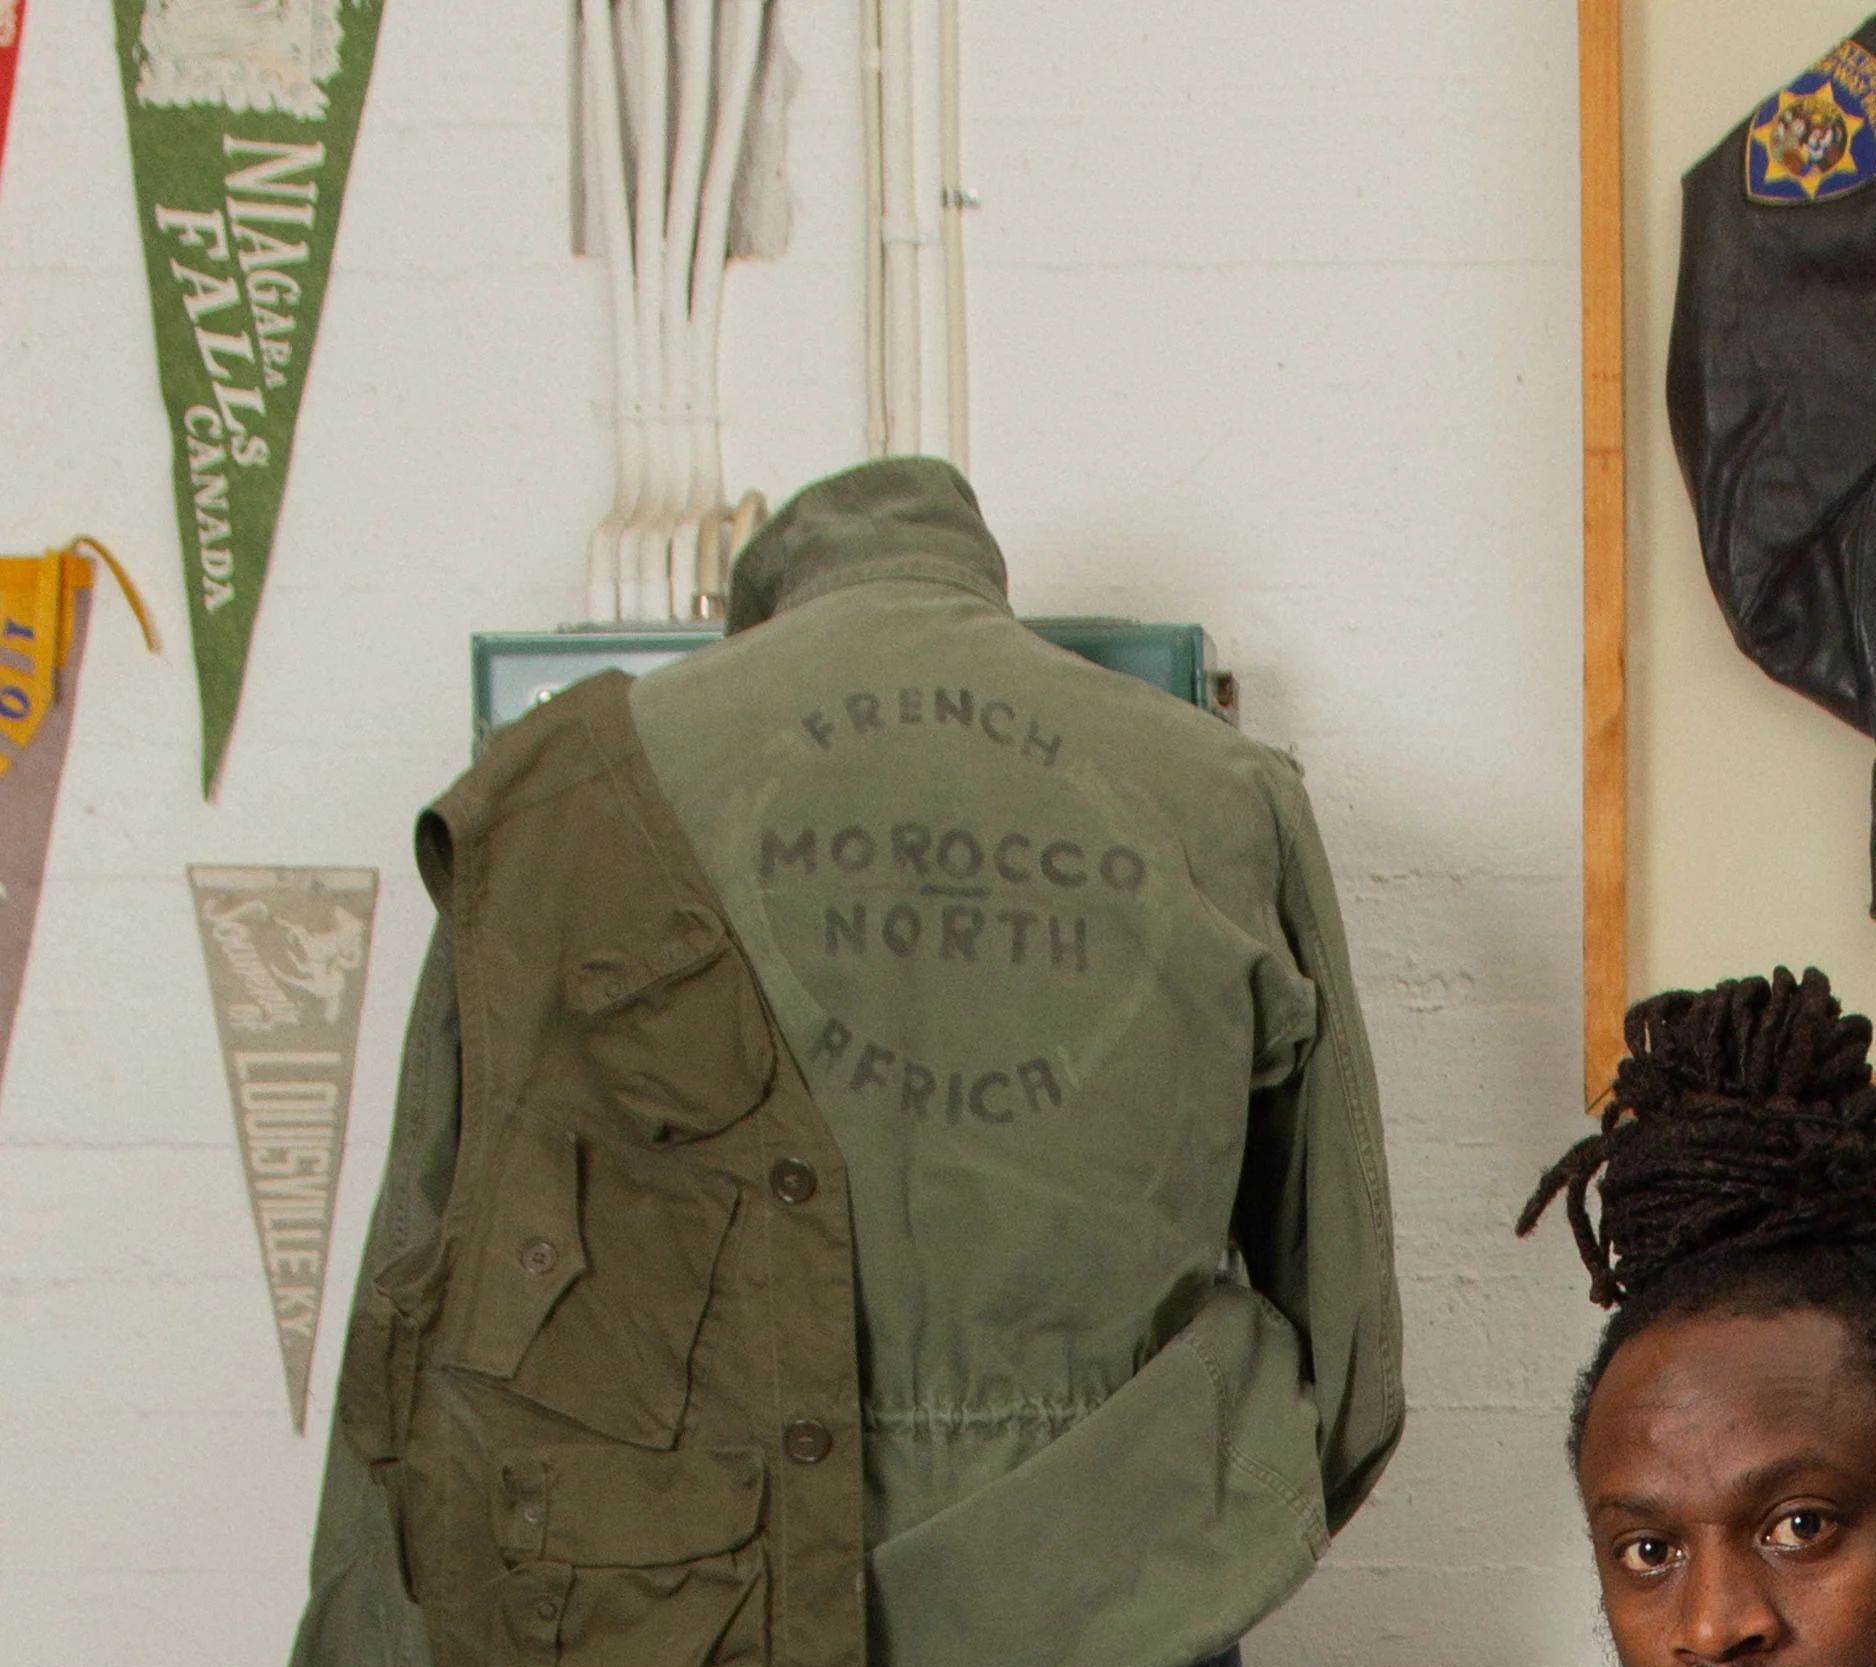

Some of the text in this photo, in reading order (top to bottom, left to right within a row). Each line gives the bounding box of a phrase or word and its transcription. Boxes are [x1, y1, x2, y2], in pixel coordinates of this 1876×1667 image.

[222, 132, 326, 392] NIAGARA
[155, 202, 270, 468] FALLS
[184, 403, 236, 617] CANADA
[801, 686, 1063, 768] FRENCH
[757, 822, 1147, 892] MOROCCO
[824, 903, 1089, 973] NORTH
[806, 1016, 1064, 1127] AFRICA
